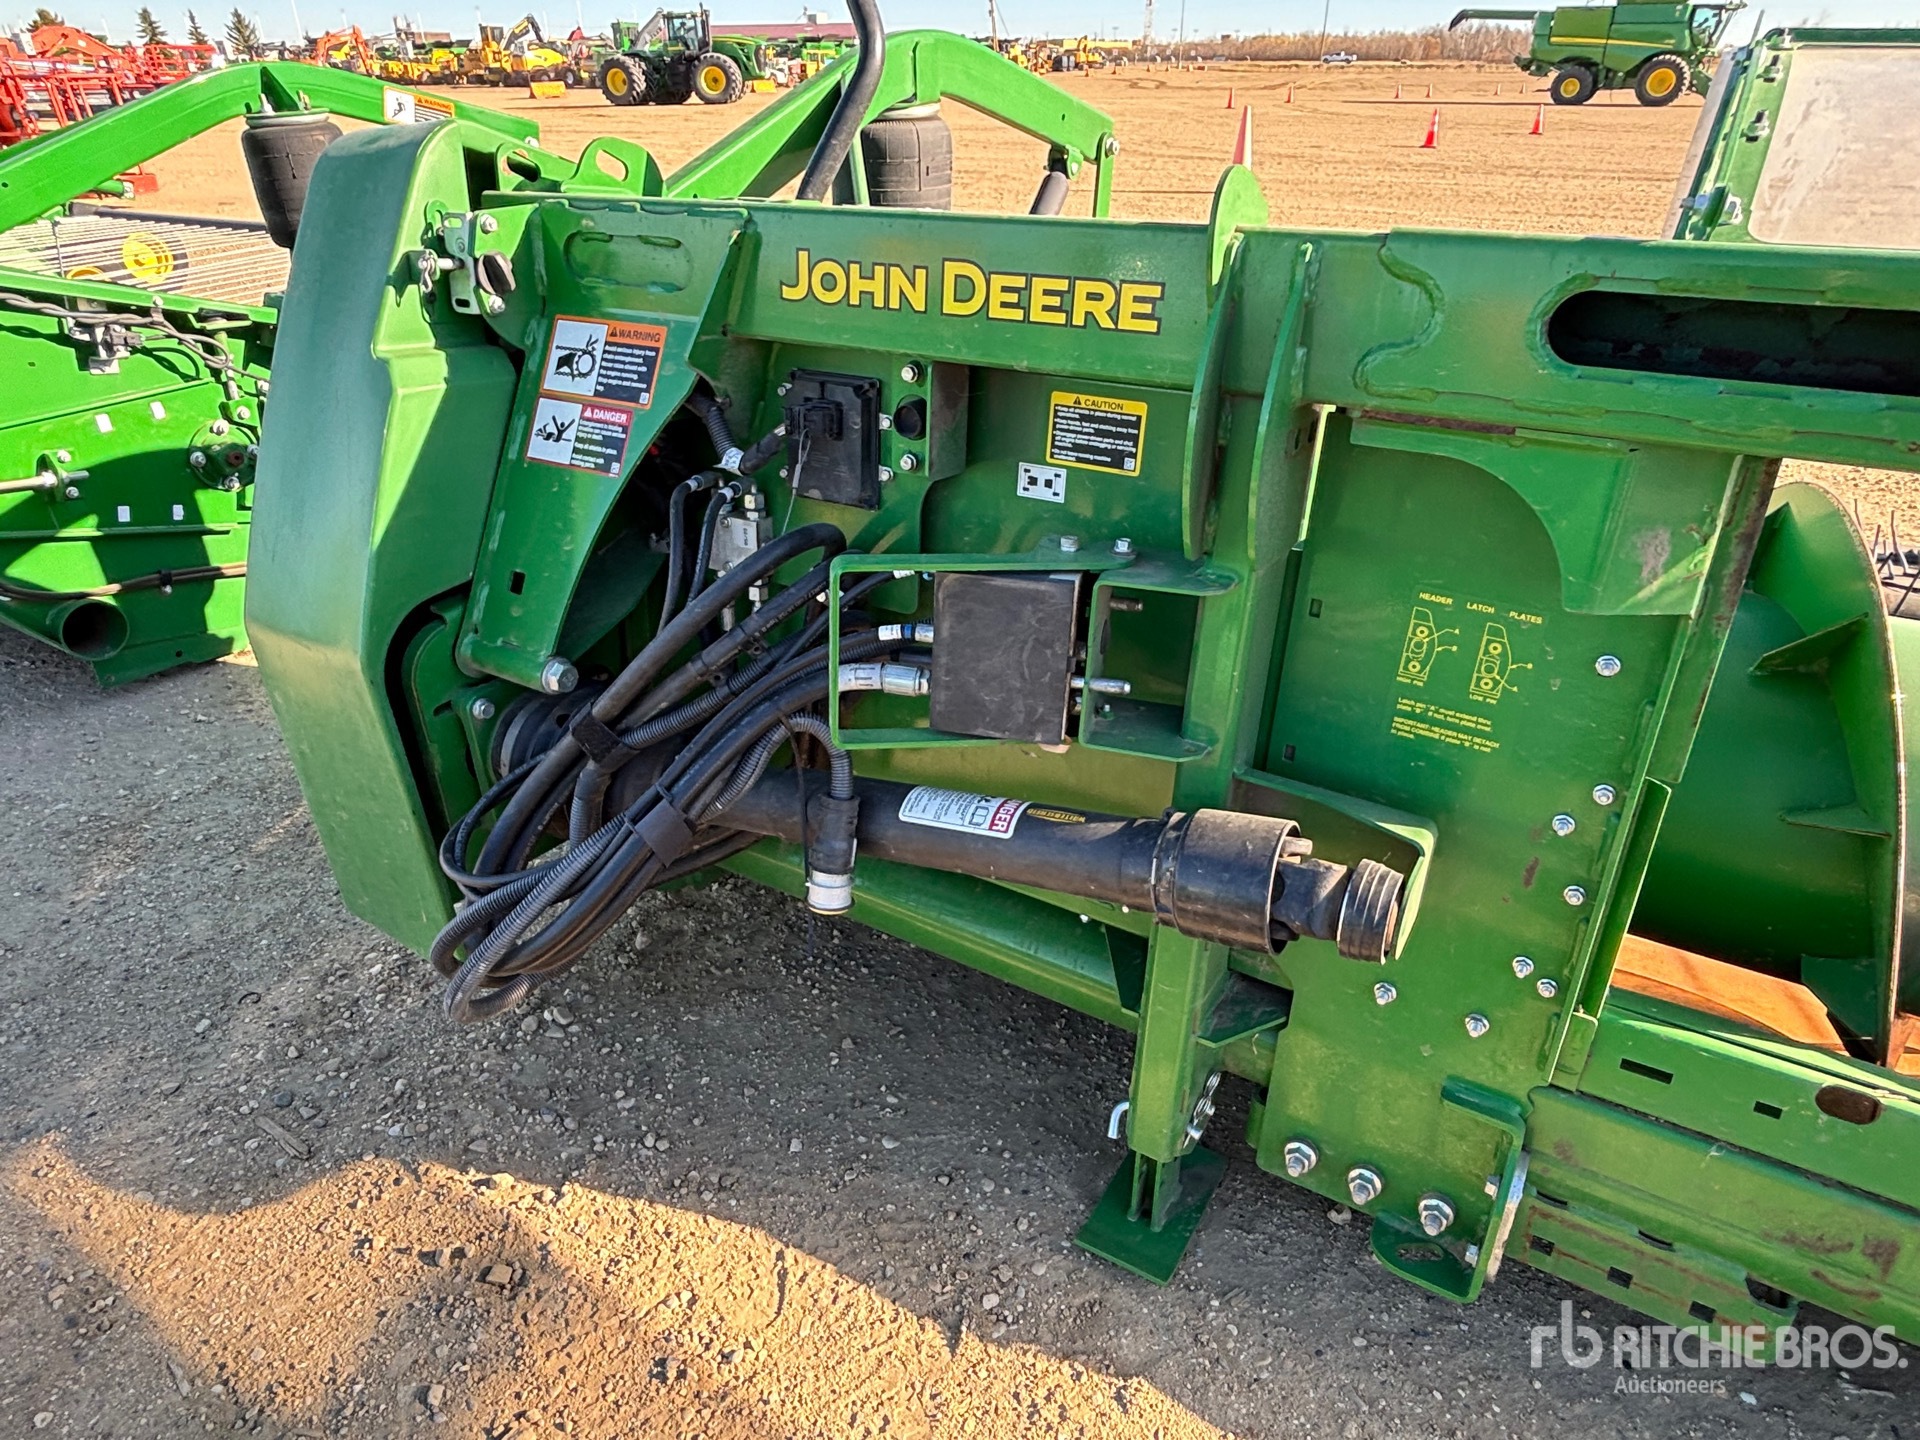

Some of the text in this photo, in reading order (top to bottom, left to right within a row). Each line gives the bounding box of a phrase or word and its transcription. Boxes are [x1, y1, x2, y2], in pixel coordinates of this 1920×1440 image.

[424, 99, 451, 110] WARNING
[780, 247, 1166, 336] JOHN DEERE
[619, 328, 661, 342] WARNING
[1084, 399, 1124, 411] CAUTION
[593, 410, 627, 422] DANGER
[1419, 592, 1543, 624] HEADER LATCH PLATES
[1469, 694, 1483, 702] LOW
[992, 798, 1023, 831] NGER
